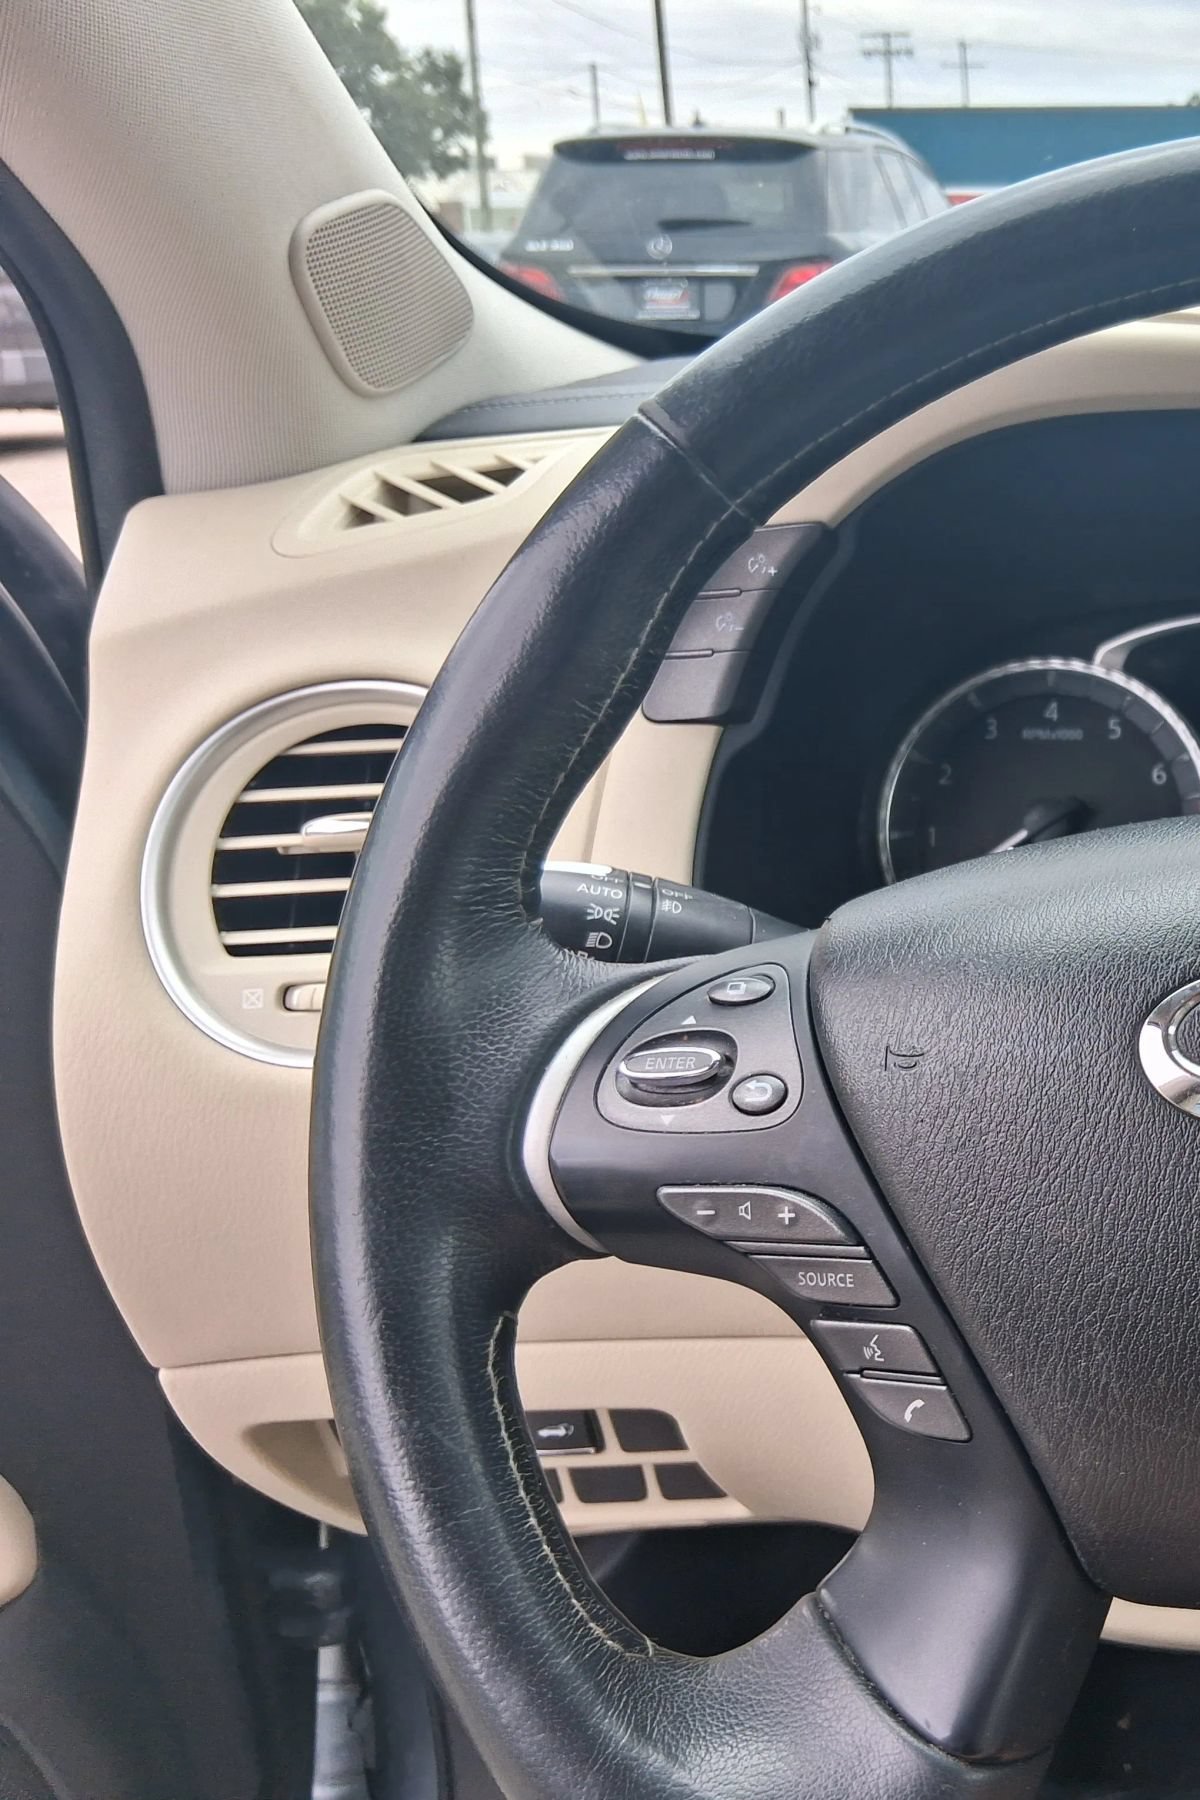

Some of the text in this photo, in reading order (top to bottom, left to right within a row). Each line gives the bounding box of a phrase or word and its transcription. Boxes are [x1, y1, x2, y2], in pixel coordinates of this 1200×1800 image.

[1044, 702, 1058, 721] 4
[984, 720, 998, 740] 3
[1108, 720, 1122, 739] 5
[938, 765, 952, 785] 2
[1151, 765, 1167, 785] 6
[928, 826, 936, 847] 1
[576, 883, 623, 900] AUTO
[661, 888, 694, 900] OFF
[644, 1055, 696, 1070] ENTER
[798, 1271, 855, 1288] SOURCE
